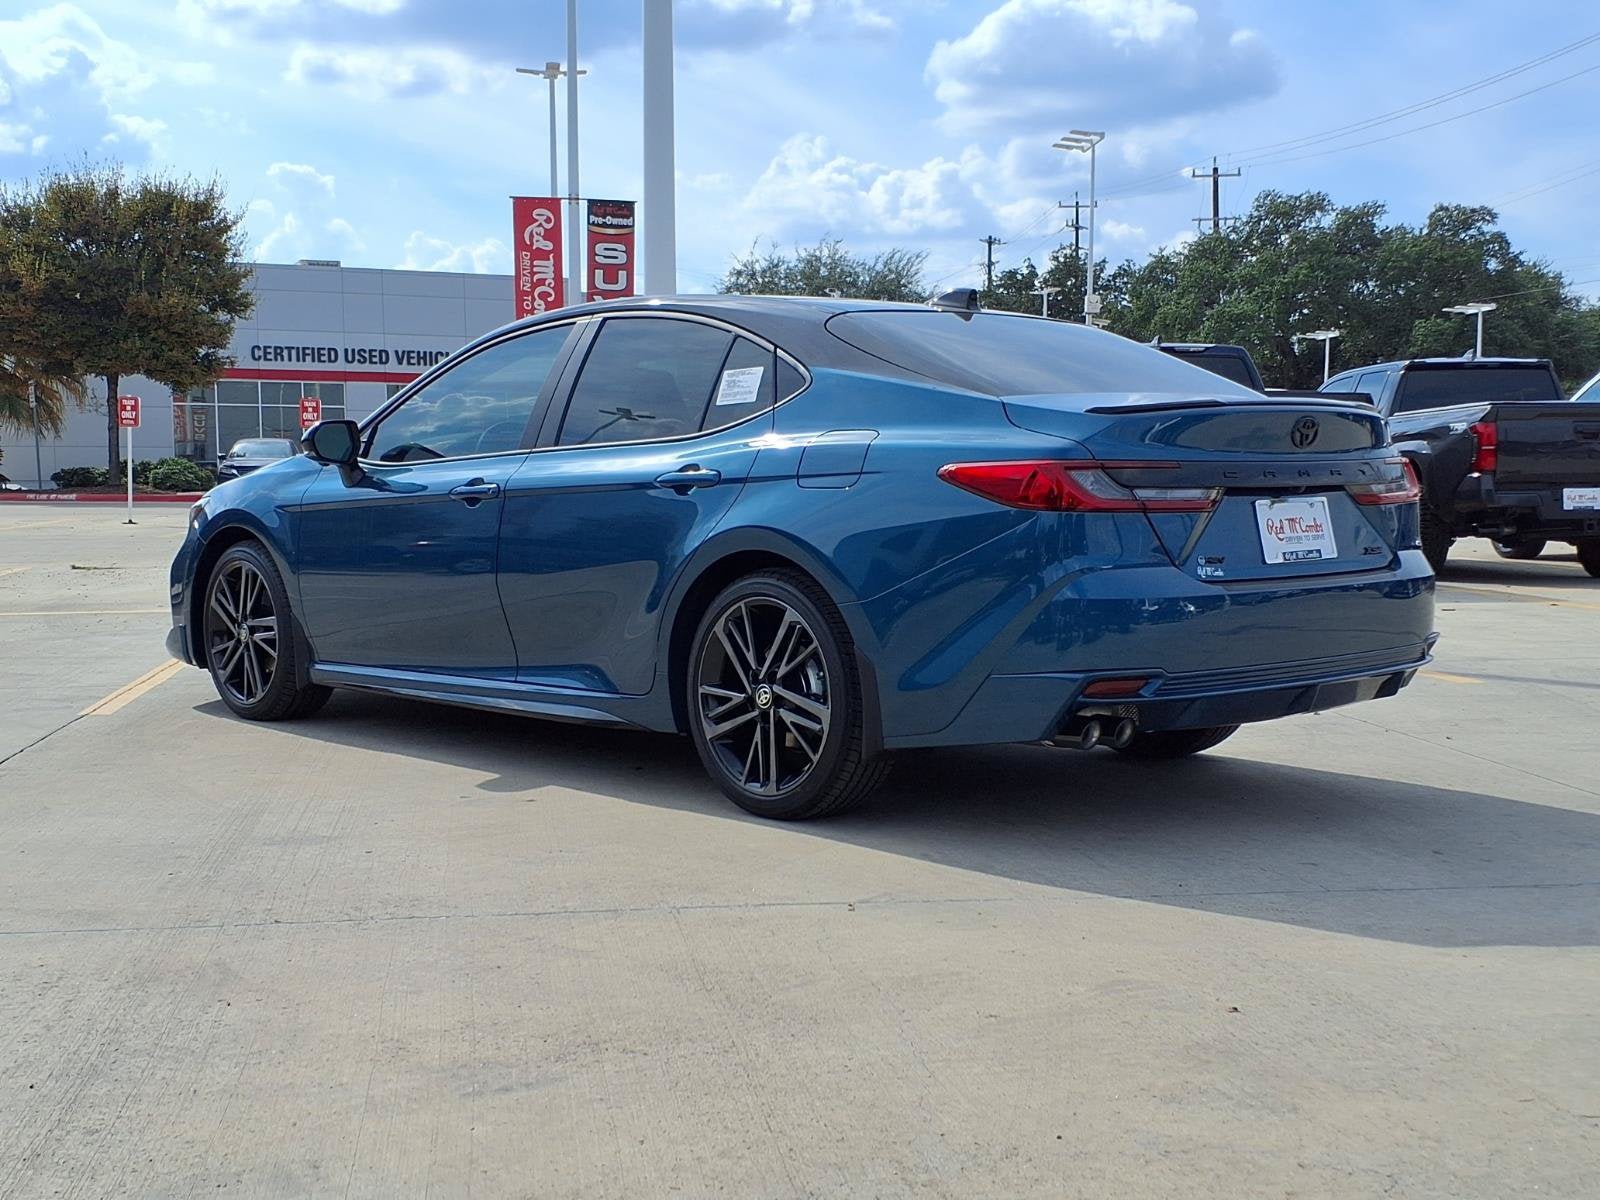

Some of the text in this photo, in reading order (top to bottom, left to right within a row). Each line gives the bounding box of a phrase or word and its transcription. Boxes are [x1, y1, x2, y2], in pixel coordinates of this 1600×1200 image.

[589, 215, 633, 226] Pre-Owned
[524, 208, 555, 251] Red
[522, 251, 531, 291] DRIVEN
[523, 296, 532, 310] TO
[251, 345, 339, 363] CERTIFIED
[345, 348, 390, 365] USED
[121, 411, 136, 419] ONLY
[302, 412, 317, 420] ONLY
[1223, 468, 1367, 479] CAMRY
[1266, 517, 1324, 541] Red McCombs
